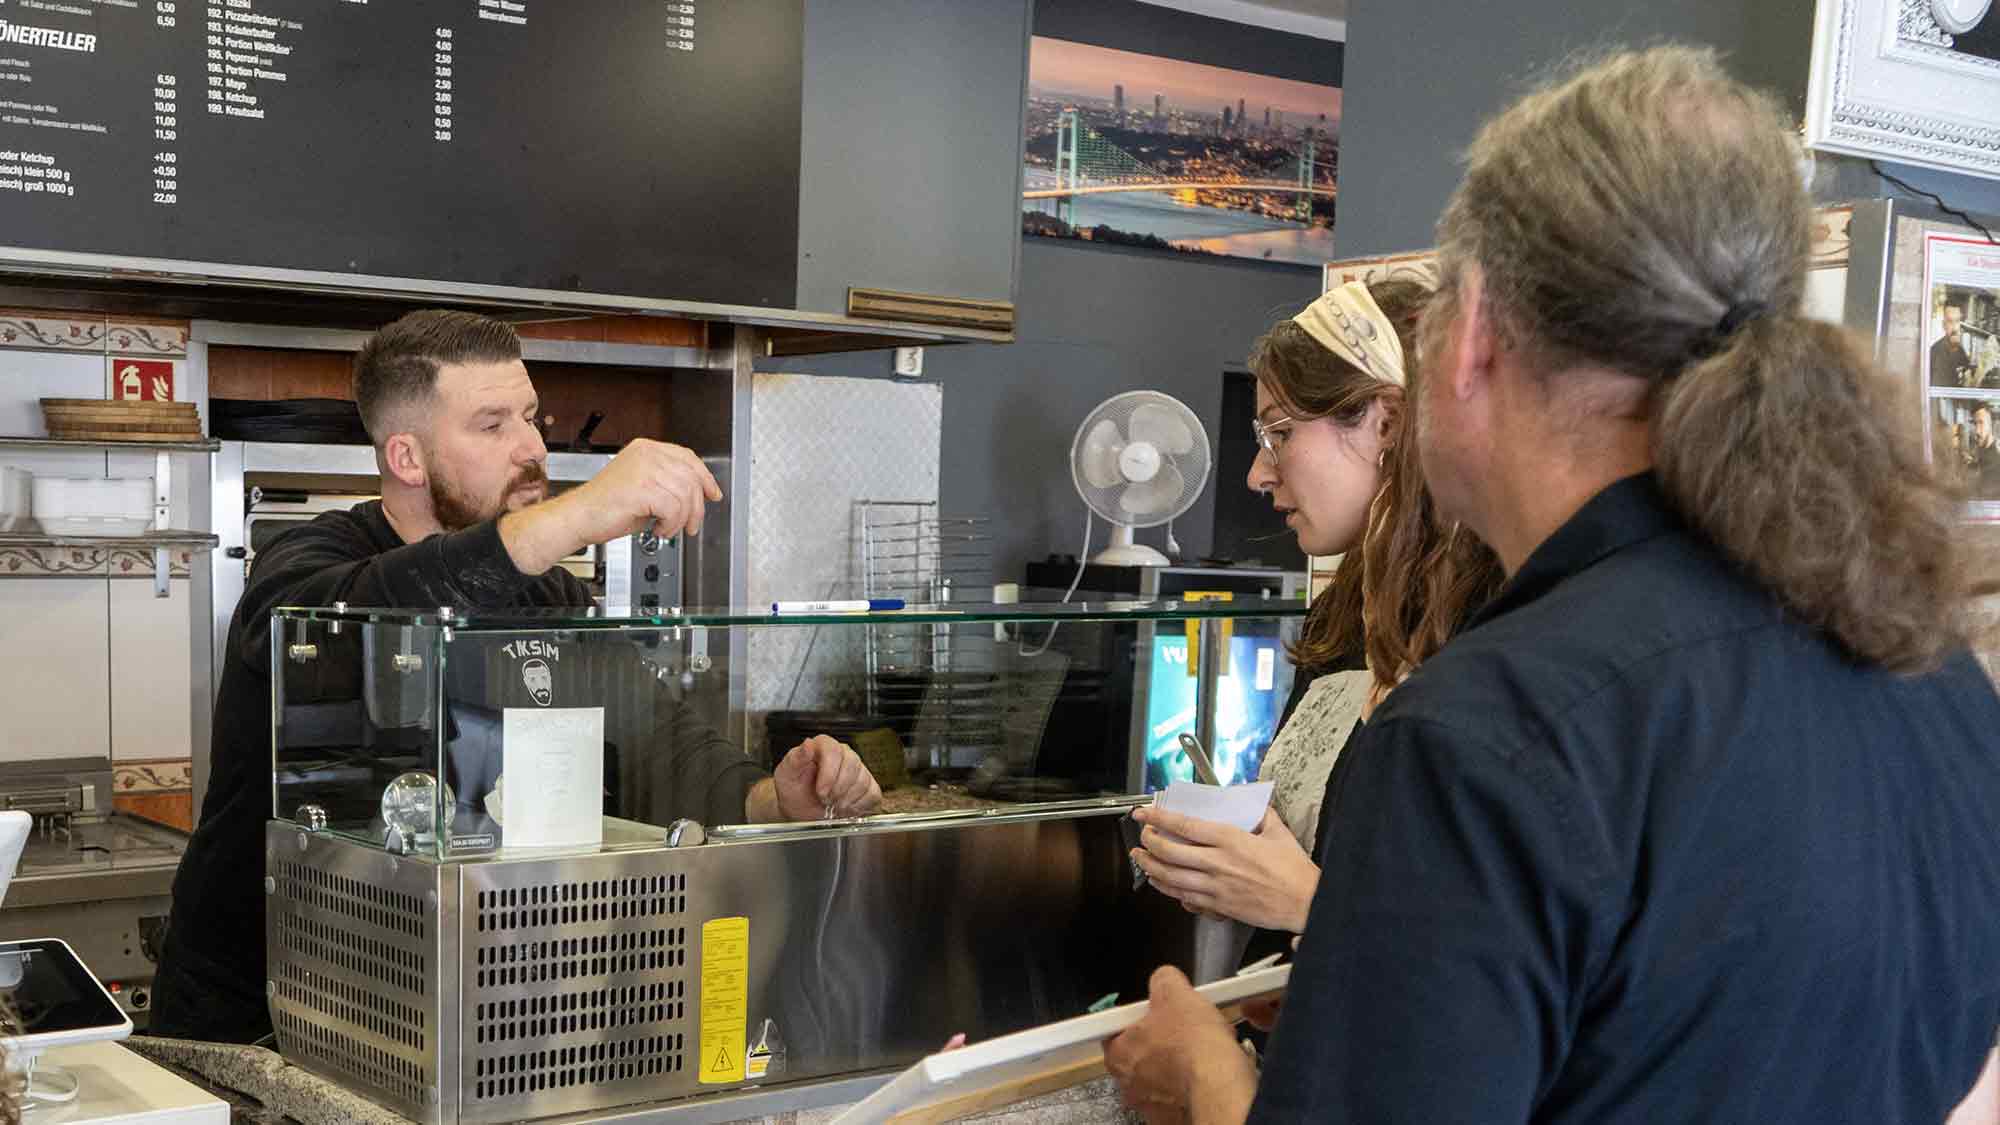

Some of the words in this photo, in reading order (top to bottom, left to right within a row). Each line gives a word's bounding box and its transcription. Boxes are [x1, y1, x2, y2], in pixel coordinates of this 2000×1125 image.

[156, 1, 176, 13] 6,50
[156, 15, 176, 27] 6,50
[225, 37, 253, 50] Portion
[225, 50, 259, 64] Peperoni
[225, 64, 253, 77] Portion
[253, 68, 287, 81] Pommes
[157, 74, 176, 86] 6,50
[225, 78, 247, 91] Mayo
[154, 88, 176, 99] 10,00
[225, 91, 257, 106] Ketchup
[154, 102, 176, 113] 10,00
[155, 116, 176, 127] 11,00
[155, 130, 176, 141] 11,50
[0, 150, 19, 161] oder
[20, 151, 55, 166] Ketchup
[154, 152, 177, 163] +1,00
[24, 166, 45, 178] klein
[46, 168, 63, 180] 500
[63, 171, 71, 182] g
[153, 166, 177, 177] +0,50
[24, 181, 45, 193] groß
[46, 183, 67, 194] 1000
[67, 186, 75, 197] g
[155, 180, 177, 191] 11,00
[153, 193, 177, 204] 22,00
